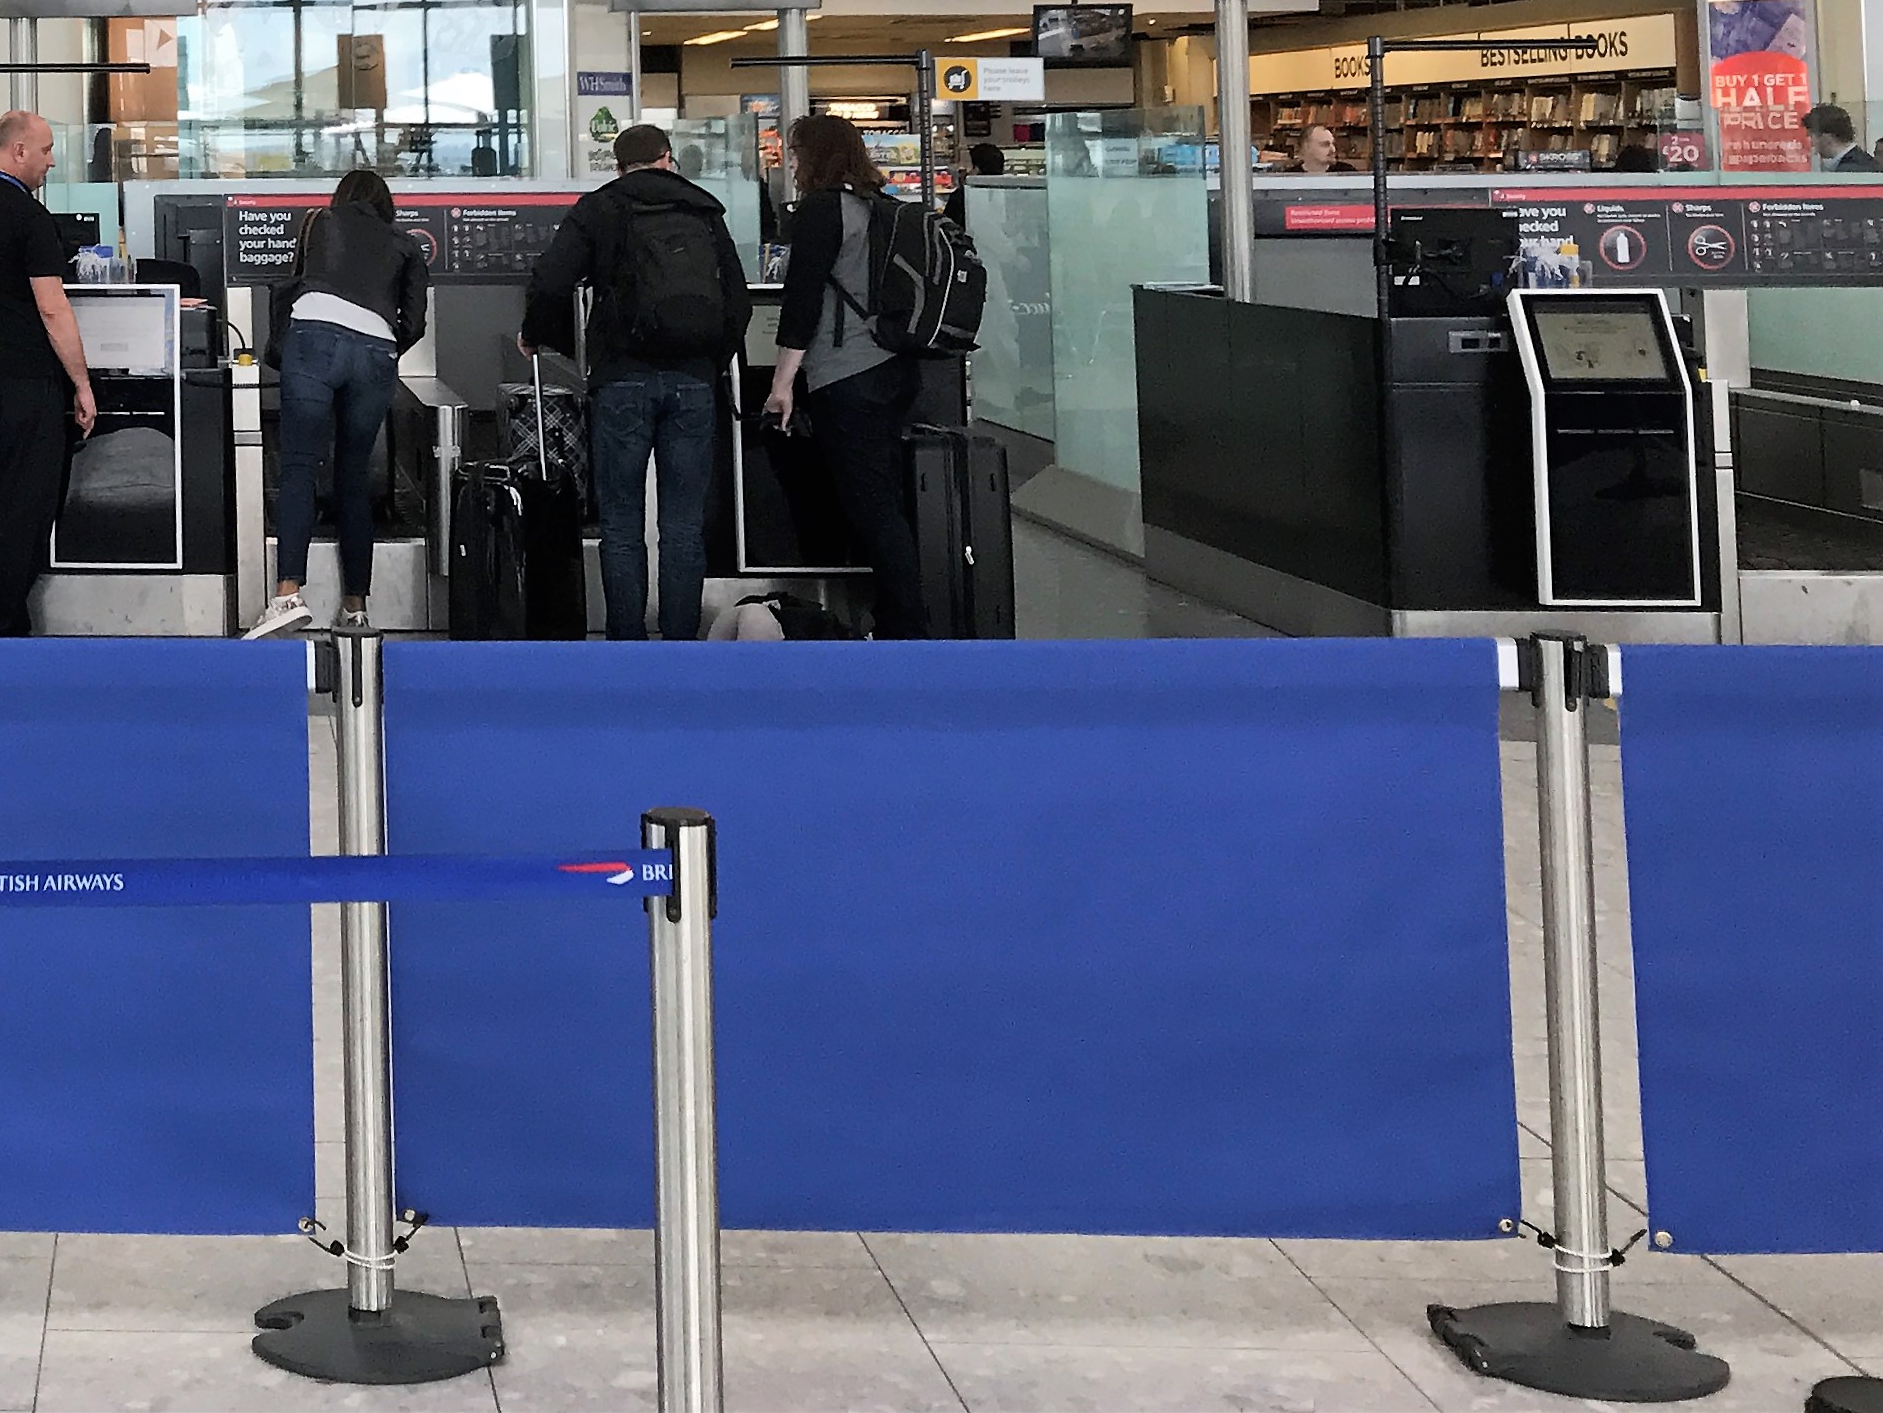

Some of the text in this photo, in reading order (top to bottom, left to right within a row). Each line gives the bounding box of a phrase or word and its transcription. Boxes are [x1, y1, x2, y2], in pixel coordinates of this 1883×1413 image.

[1575, 31, 1629, 60] BOOKS
[1335, 55, 1371, 78] BOOKS
[579, 76, 627, 91] WHSmith
[1715, 73, 1807, 87] BUY 1 GET 1
[1716, 86, 1808, 110] HALF
[1723, 112, 1799, 130] PRICE
[1671, 136, 1679, 145] 2
[239, 211, 291, 224] Have you
[1519, 207, 1567, 220] ave you
[239, 224, 284, 235] checked
[1519, 221, 1559, 233] ecked
[239, 239, 266, 251] your
[239, 252, 294, 265] baggage?
[642, 863, 673, 881] BRI
[43, 873, 124, 891] AIRWAYS
